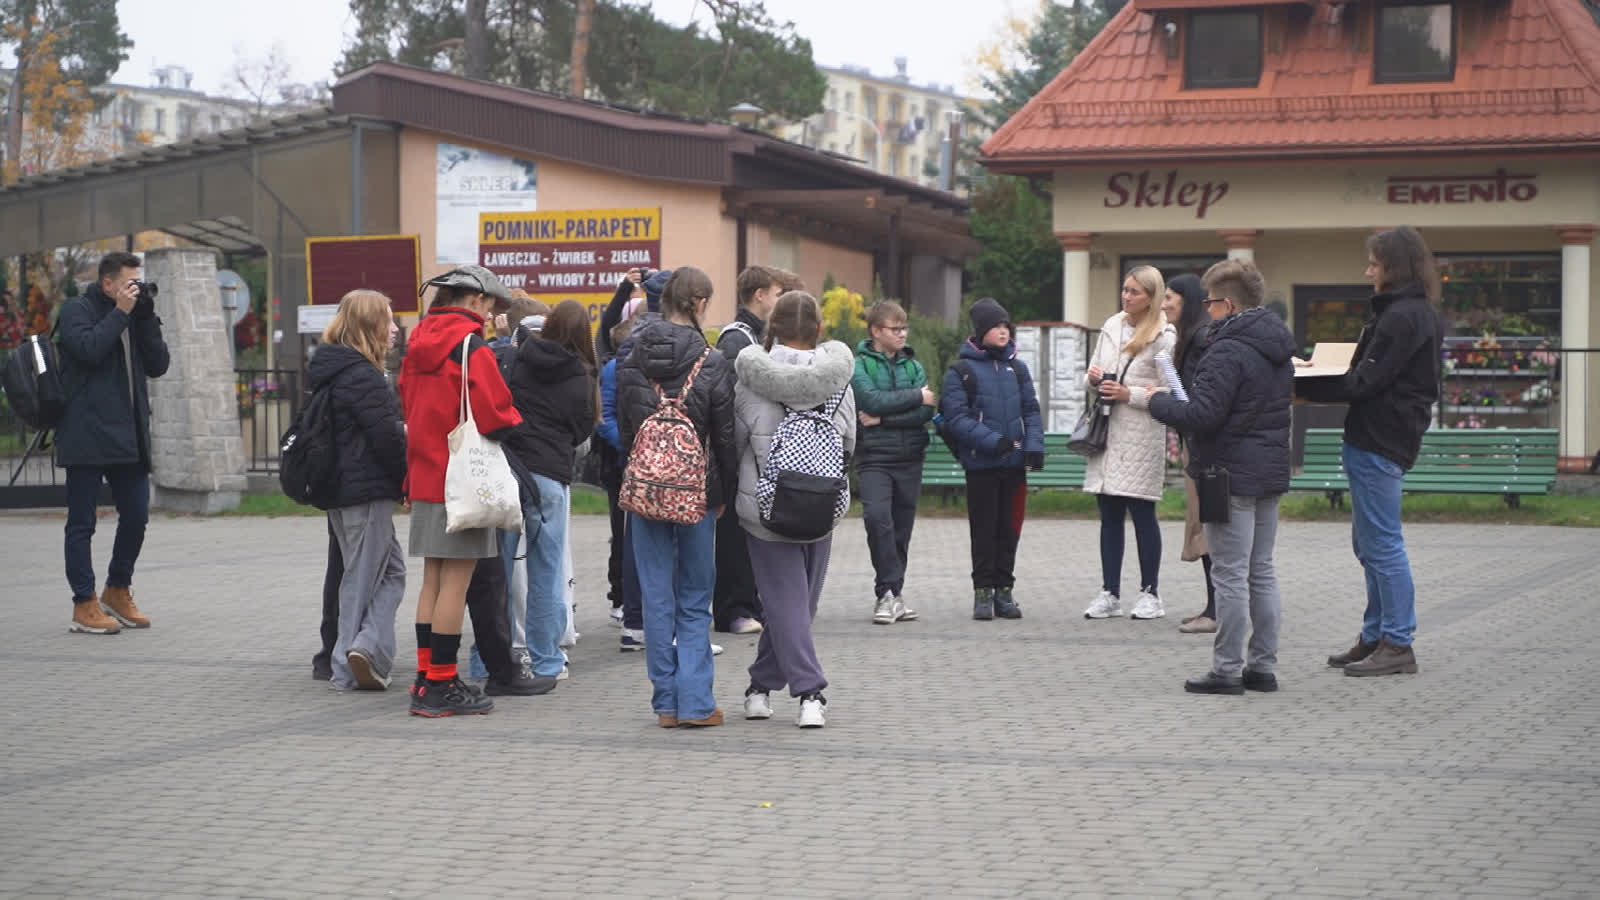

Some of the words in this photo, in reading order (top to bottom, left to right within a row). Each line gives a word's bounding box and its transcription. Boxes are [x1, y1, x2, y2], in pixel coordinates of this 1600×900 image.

[1104, 170, 1229, 219] Sklep
[483, 216, 653, 241] POMNIKI-PARAPETY
[484, 252, 541, 266] ŁAWECZKI
[552, 248, 596, 265] ŻWIREK
[610, 249, 651, 265] ZIEMIA
[497, 273, 527, 288] ZONY
[538, 272, 586, 288] WYROBY
[587, 272, 596, 287] Z
